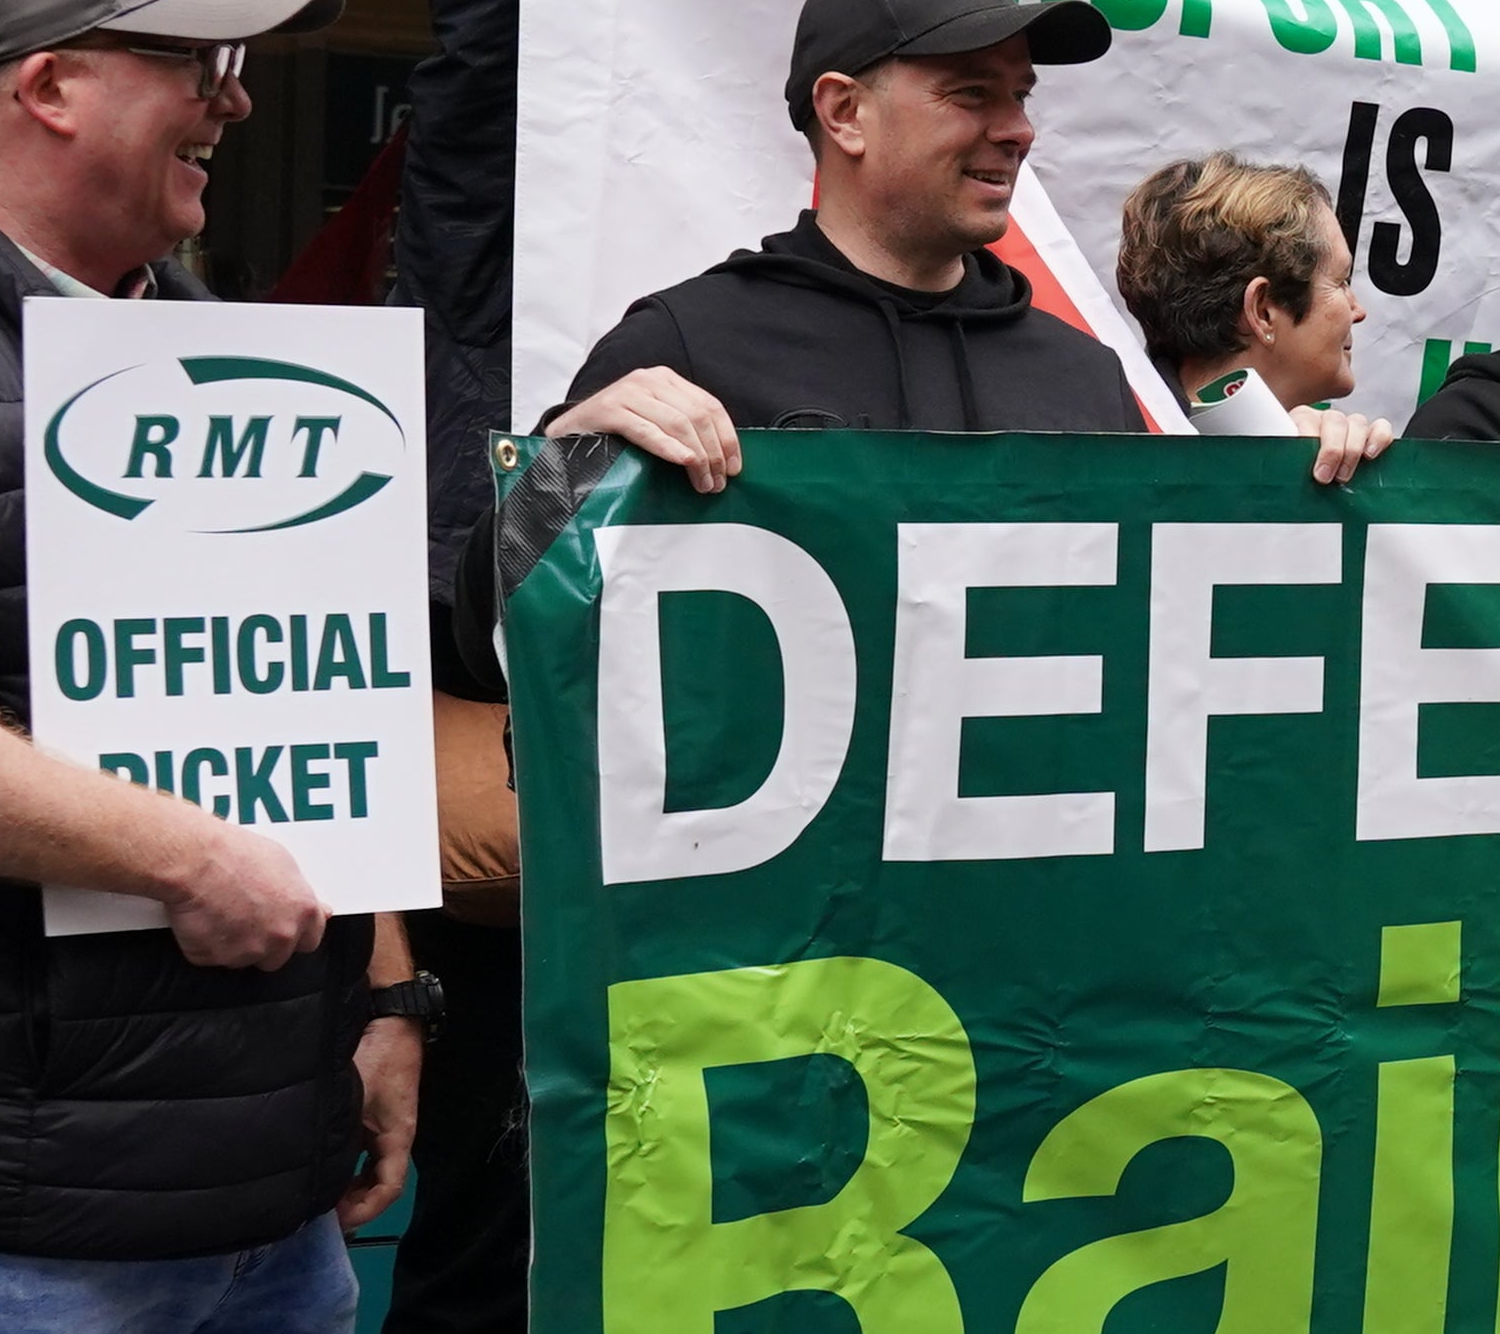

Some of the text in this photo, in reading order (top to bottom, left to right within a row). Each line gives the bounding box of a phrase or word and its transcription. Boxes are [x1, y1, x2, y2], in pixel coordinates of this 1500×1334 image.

[1336, 102, 1453, 296] IS
[123, 413, 343, 479] RMT
[54, 610, 412, 701] OFFICIAL
